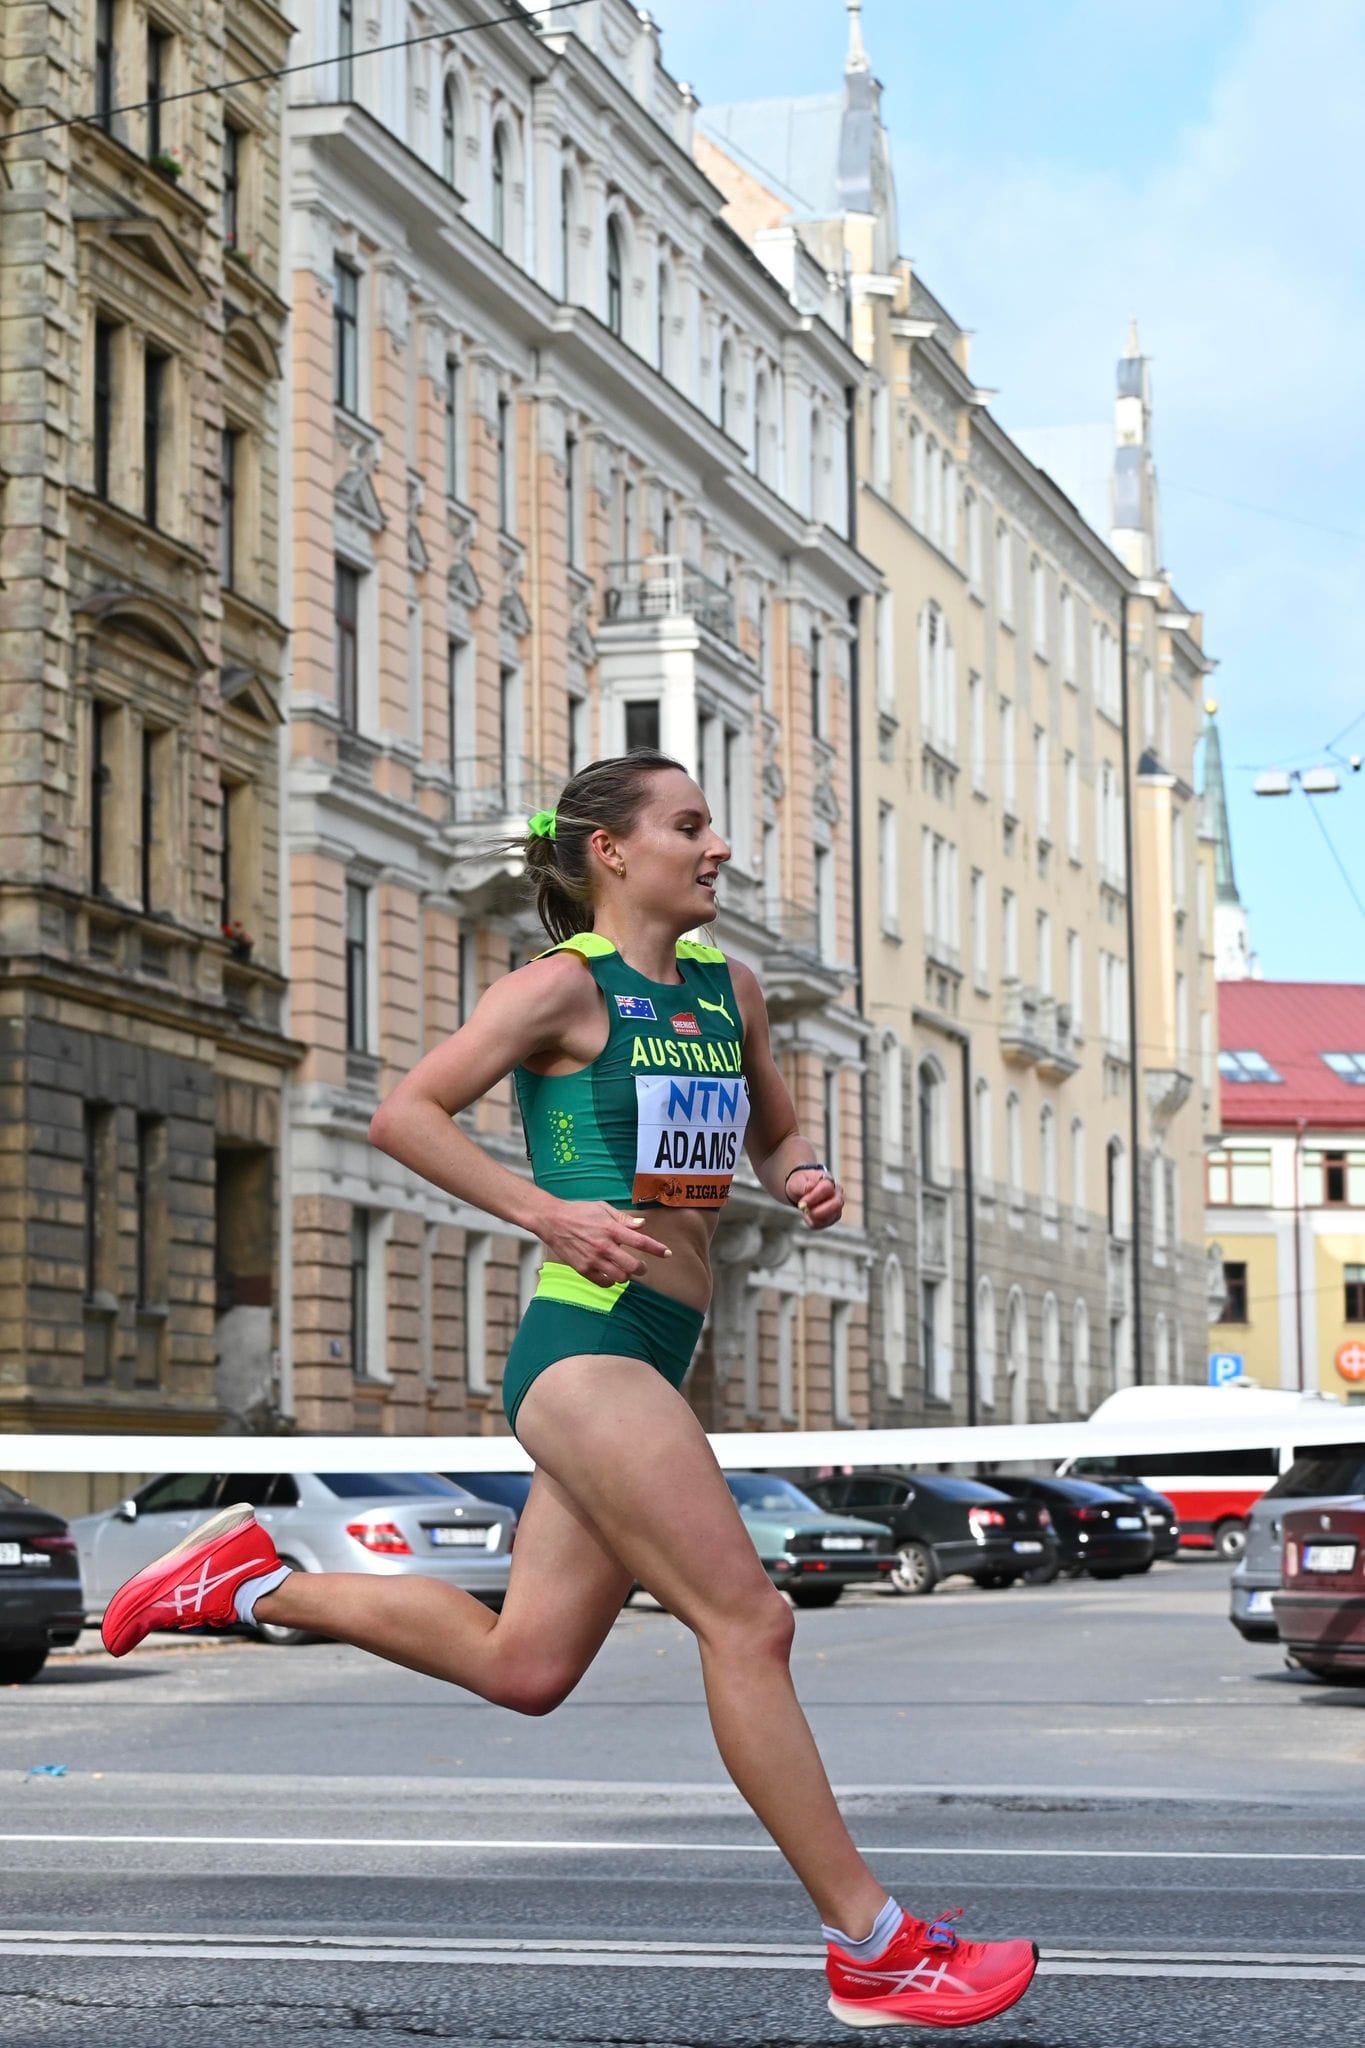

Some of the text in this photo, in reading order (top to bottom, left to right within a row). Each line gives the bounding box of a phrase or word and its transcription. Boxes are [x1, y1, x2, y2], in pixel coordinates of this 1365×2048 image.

[667, 1079, 739, 1123] NTN
[654, 1130, 737, 1170] ADAMS
[685, 1184, 718, 1199] RIGA
[1215, 1356, 1236, 1386] P
